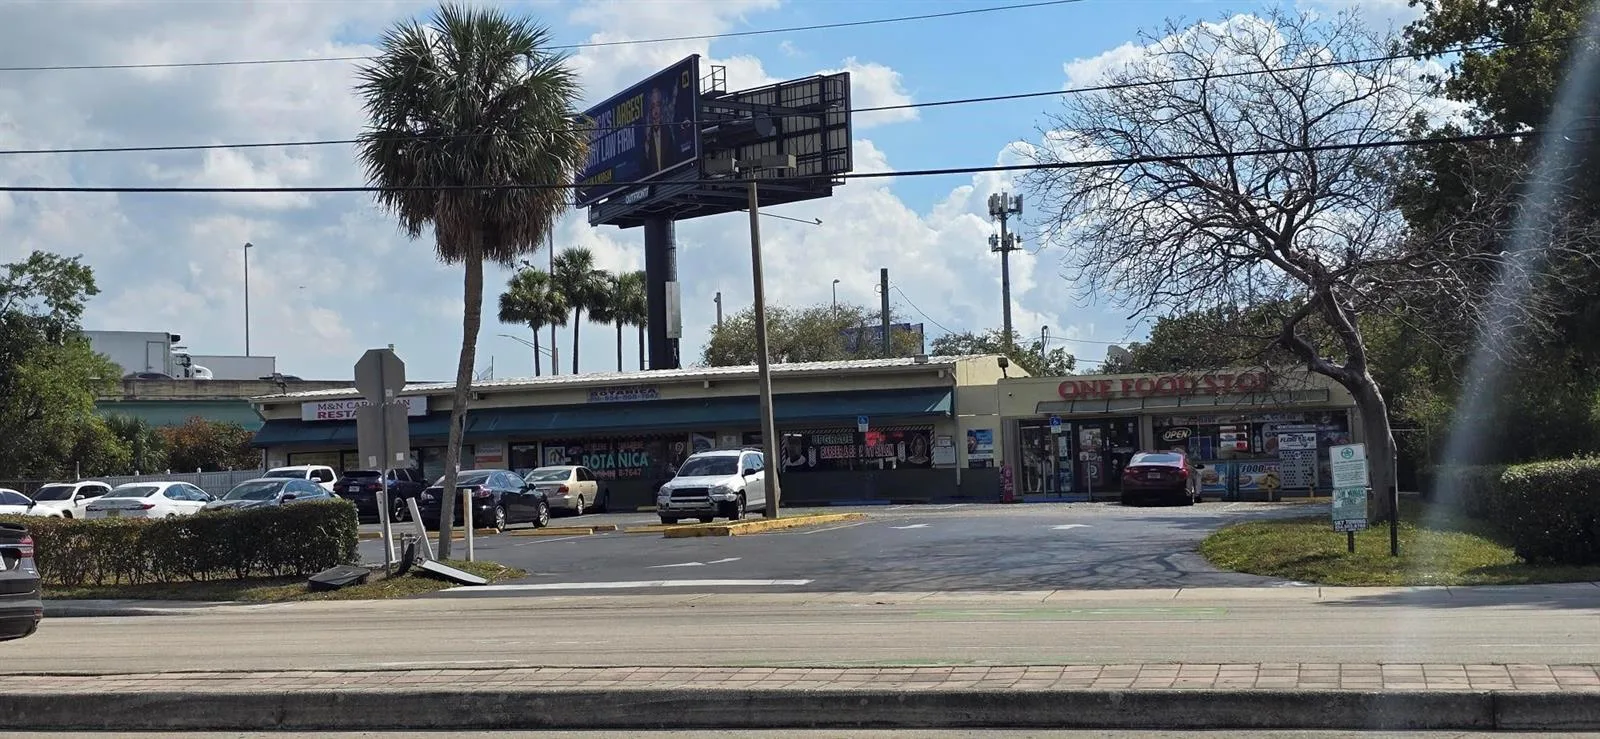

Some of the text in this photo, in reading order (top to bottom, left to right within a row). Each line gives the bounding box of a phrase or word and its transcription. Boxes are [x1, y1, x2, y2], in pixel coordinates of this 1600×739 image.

[612, 93, 644, 128] LARGEST
[601, 132, 616, 162] LAW
[617, 127, 635, 155] FIRM
[1058, 380, 1112, 400] ONE
[1121, 376, 1196, 397] FOOD
[317, 402, 344, 411] M&N
[811, 432, 853, 445] UPGRADE
[1164, 430, 1189, 439] OPEN
